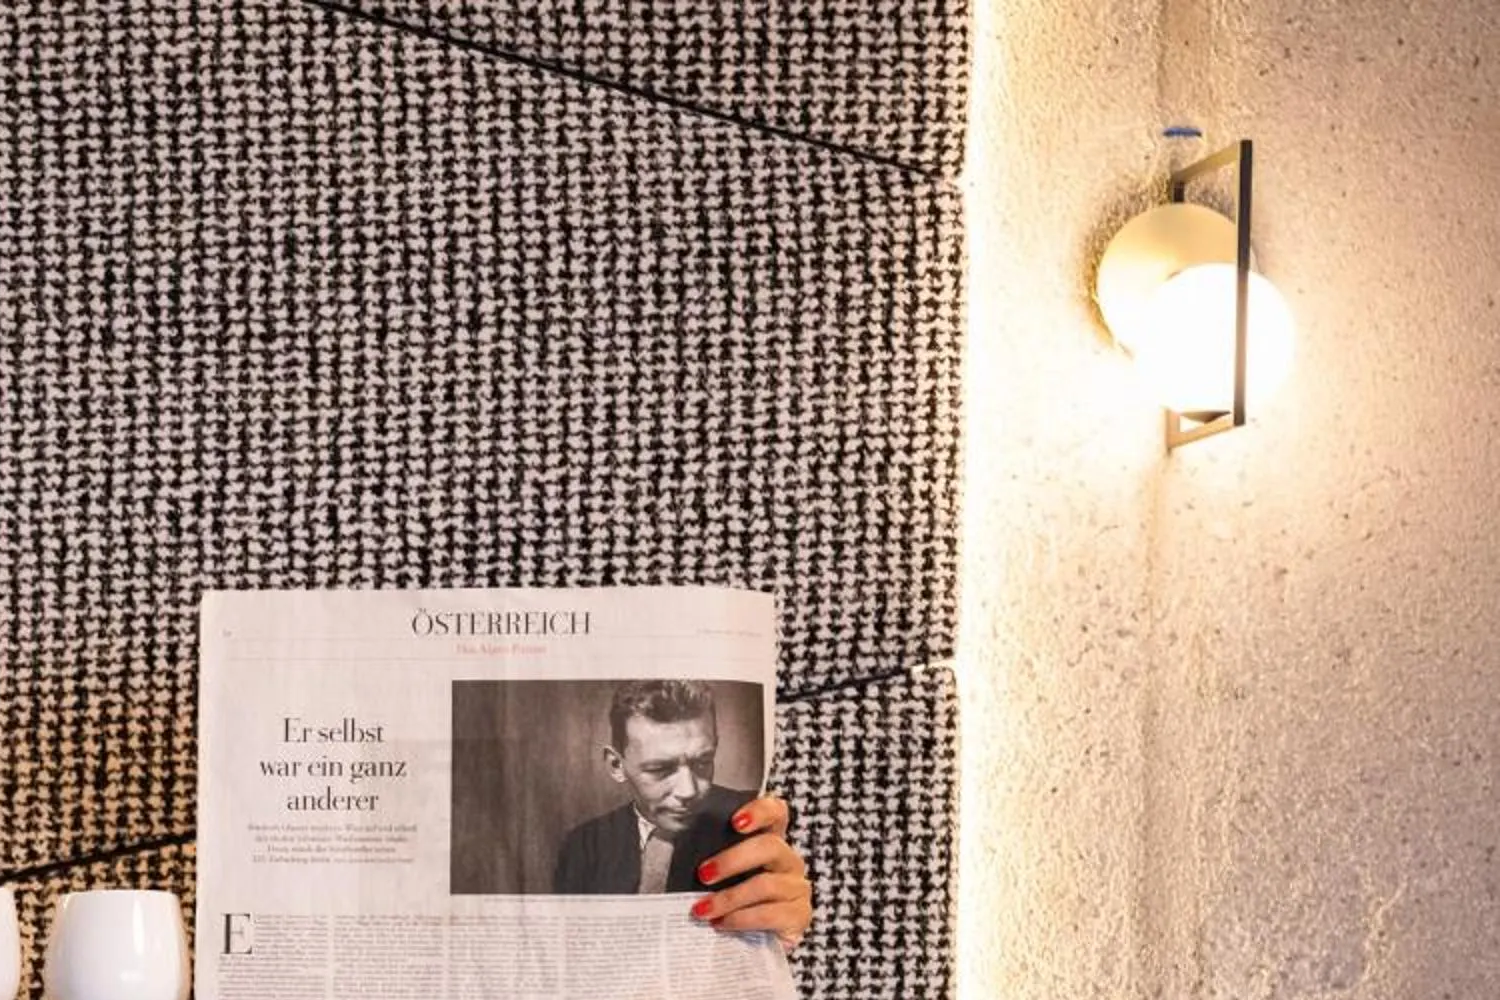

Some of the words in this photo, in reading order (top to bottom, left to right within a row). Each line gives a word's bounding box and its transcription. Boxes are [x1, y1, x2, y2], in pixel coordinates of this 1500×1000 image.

[412, 608, 590, 636] ÖSTERREICH
[284, 717, 312, 743] Er
[317, 717, 384, 743] selbst
[260, 761, 301, 777] war
[307, 756, 342, 777] ein
[350, 761, 407, 784] ganz
[287, 786, 379, 811] anderer
[221, 913, 252, 954] E
